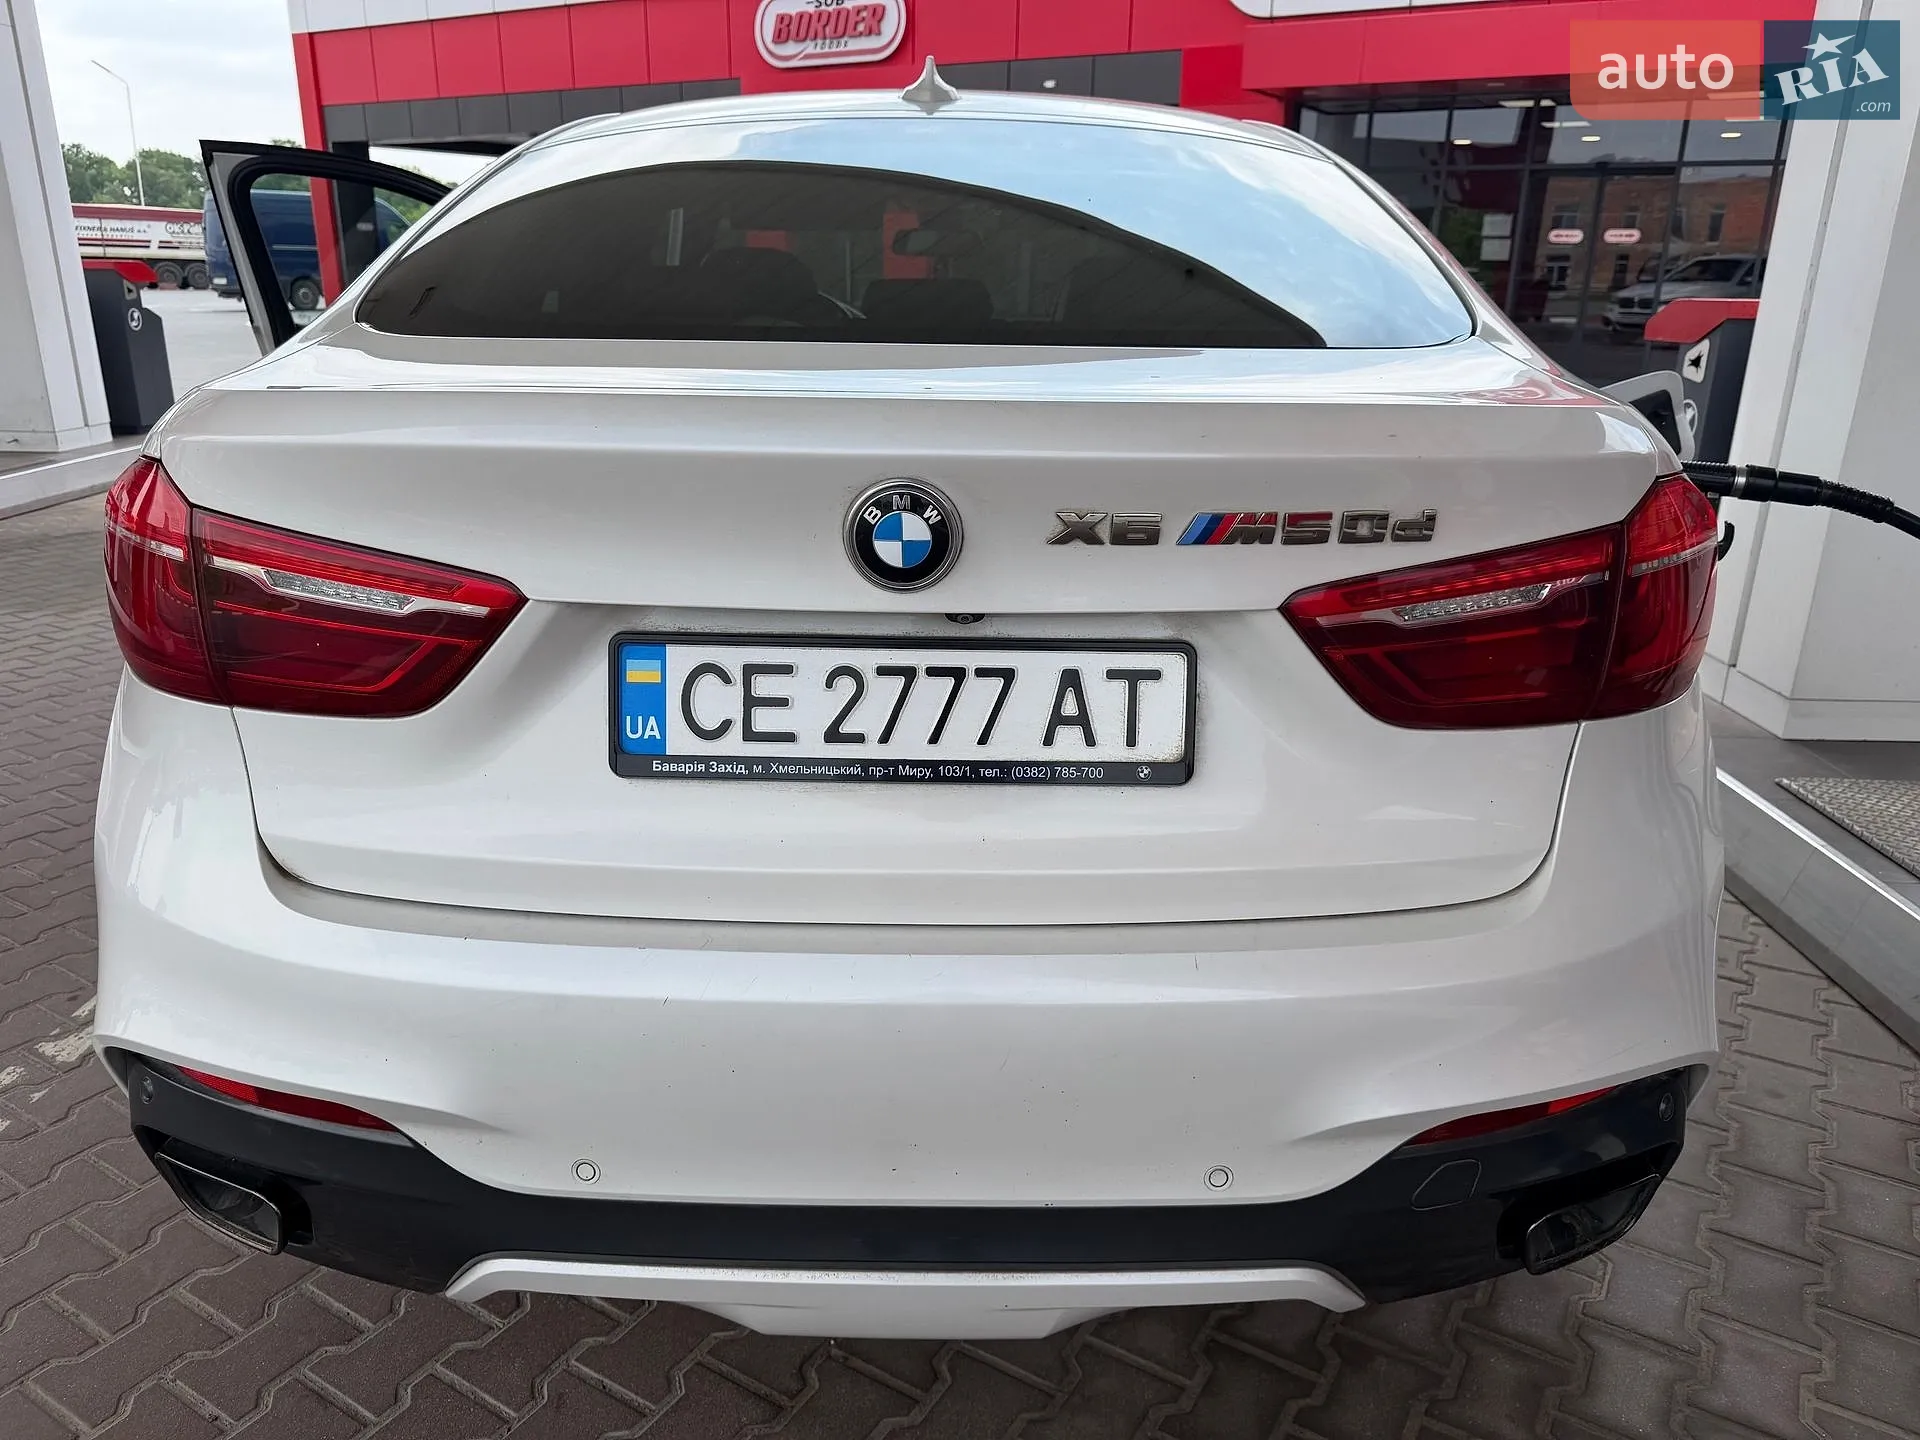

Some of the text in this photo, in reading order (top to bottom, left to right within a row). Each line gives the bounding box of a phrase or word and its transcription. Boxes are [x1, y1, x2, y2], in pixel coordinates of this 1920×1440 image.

[772, 3, 886, 45] BORDER
[863, 495, 942, 525] BMW
[1047, 509, 1438, 545] X6 M50d
[681, 662, 1164, 748] CE 2777 AT
[626, 716, 661, 740] UA
[652, 760, 1104, 780] Баварія Захід, м. Хмельницький, пр-т Миру, 103/1, тел.: (0382) 785-700
